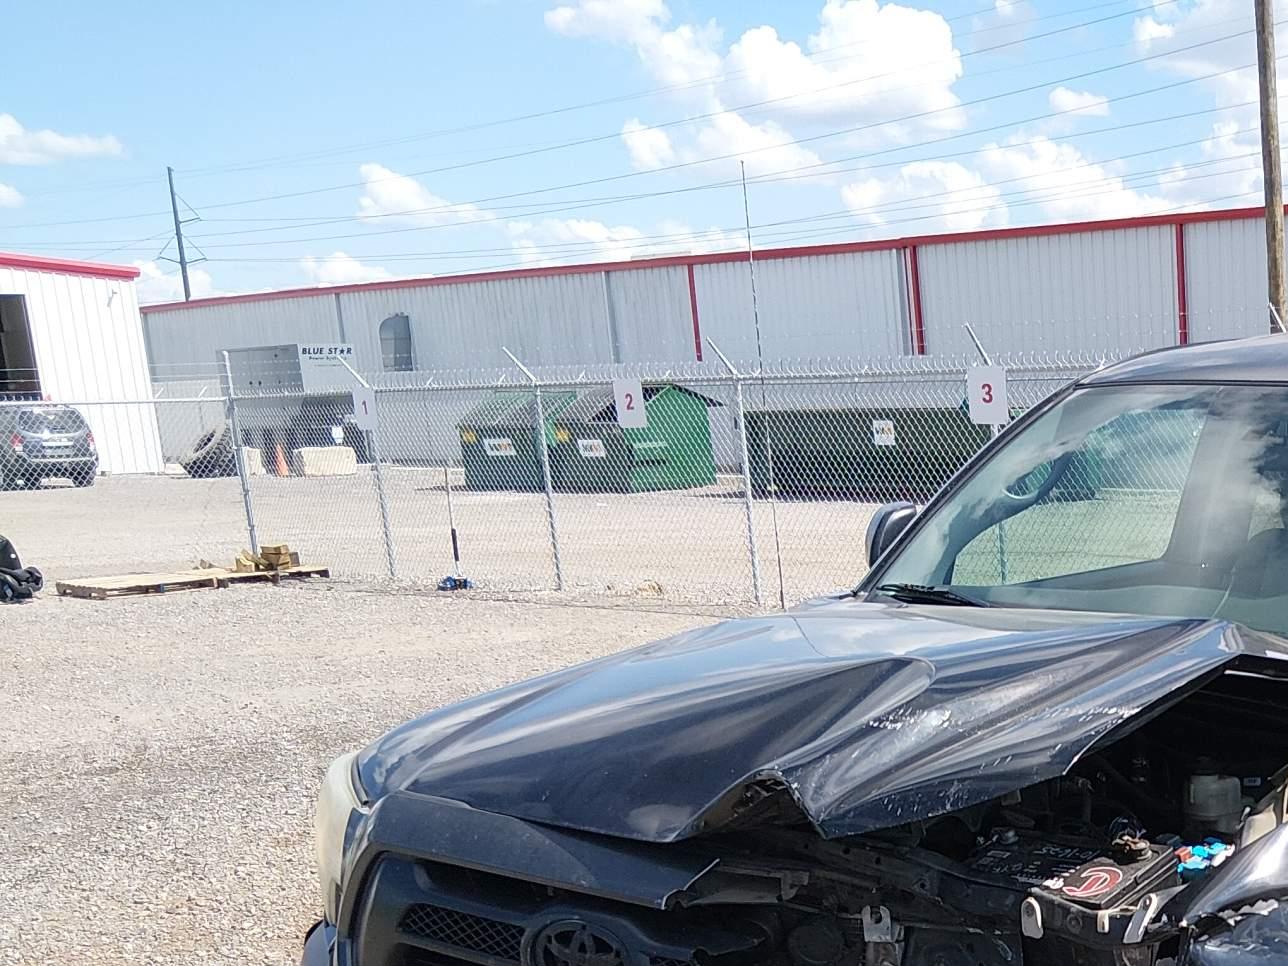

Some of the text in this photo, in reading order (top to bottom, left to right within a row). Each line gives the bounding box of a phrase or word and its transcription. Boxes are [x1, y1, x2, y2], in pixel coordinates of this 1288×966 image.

[624, 393, 635, 411] 2
[981, 383, 993, 404] 3
[361, 400, 368, 415] 1
